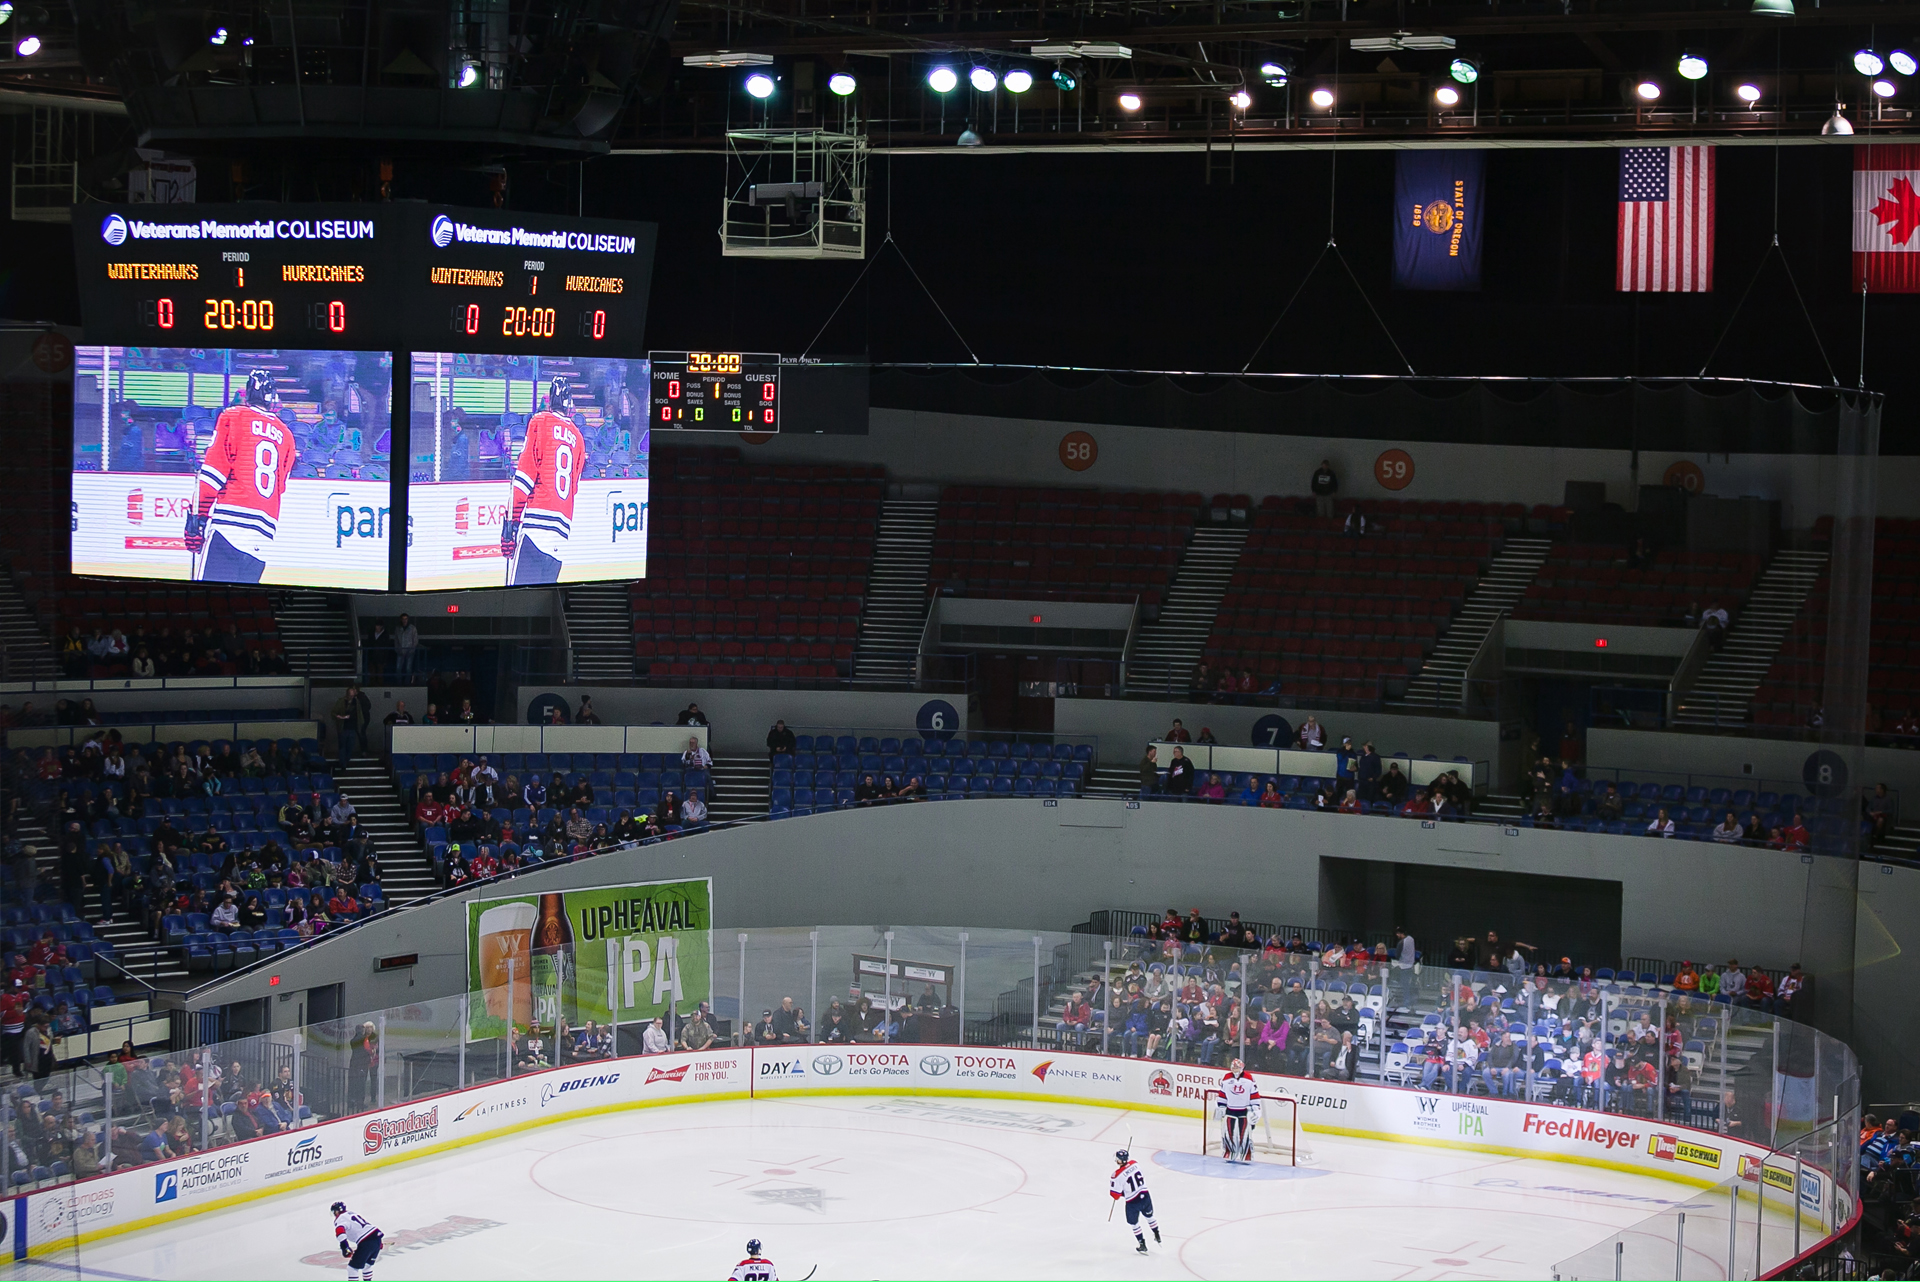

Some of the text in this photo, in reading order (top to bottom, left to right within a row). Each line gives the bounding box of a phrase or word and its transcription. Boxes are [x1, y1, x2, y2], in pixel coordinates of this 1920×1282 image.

[1455, 180, 1464, 208] STATE
[1413, 204, 1422, 226] 1859
[129, 220, 374, 239] Veterans Memorial COLISEUM
[455, 222, 636, 254] Veterans Memorial COLISEUM
[1449, 222, 1464, 256] OREGON
[222, 252, 250, 262] PERIOD
[524, 260, 544, 271] PERIOD
[108, 263, 198, 280] WINTERHAWKS
[236, 267, 244, 287] 1
[282, 265, 364, 282] HURRICANES
[431, 267, 504, 287] WINTERHAWKS
[566, 275, 624, 294] HURRICANES
[157, 298, 174, 329] 0
[204, 299, 274, 330] 20:00
[328, 301, 346, 332] 0
[466, 304, 480, 334] 0
[502, 306, 556, 336] 20:00
[593, 310, 606, 339] 0
[689, 353, 740, 372] 20:00
[654, 372, 680, 380] HOME
[745, 374, 776, 382] GUEST
[668, 380, 680, 398] 0
[714, 382, 720, 398] 1
[763, 383, 774, 400] 0
[662, 406, 671, 421] 0
[694, 408, 704, 422] 0
[732, 408, 741, 422] 0
[764, 409, 774, 423] 0
[251, 420, 283, 444] GLASS
[553, 426, 576, 448] GLASS
[1066, 442, 1090, 460] 58
[254, 440, 278, 498] 8
[555, 444, 573, 500] 8
[1382, 460, 1406, 478] 59
[931, 712, 944, 730] 6
[1266, 728, 1279, 745] 7
[1819, 764, 1832, 784] 8
[581, 898, 695, 941] UPHEAVAL
[607, 936, 684, 1011] IPA
[695, 1060, 737, 1070] THIS BUD'S
[761, 1062, 790, 1075] DAY
[847, 1054, 909, 1066] TOYOTA
[955, 1056, 1016, 1070] TOYOTA
[558, 1073, 620, 1093] BOEING
[648, 1070, 686, 1080] Budweiser
[694, 1071, 729, 1081] FOR YOU.
[990, 1071, 1016, 1079] Places
[1040, 1068, 1122, 1082] BANNER BANK
[1177, 1074, 1214, 1085] ORDER
[476, 1098, 527, 1117] LA FITNESS
[1452, 1102, 1489, 1115] UPHEAVAL
[363, 1105, 438, 1156] Standard
[943, 1114, 1062, 1133] Plumbing
[1459, 1113, 1483, 1136] IPA
[1523, 1113, 1640, 1149] Fred Meyer
[384, 1129, 437, 1149] TV & APPLIANCE
[1657, 1137, 1675, 1152] Tires
[287, 1145, 322, 1166] tcms
[1676, 1145, 1718, 1163] LES SCHWAB
[182, 1152, 249, 1177] PACIFIC OFFICE
[308, 1161, 323, 1169] ENERGY
[182, 1166, 242, 1190] AUTOMATION
[1126, 1171, 1144, 1192] 16
[1769, 1171, 1792, 1186] SCHWAB
[67, 1188, 114, 1208] compass
[67, 1201, 114, 1220] oncology
